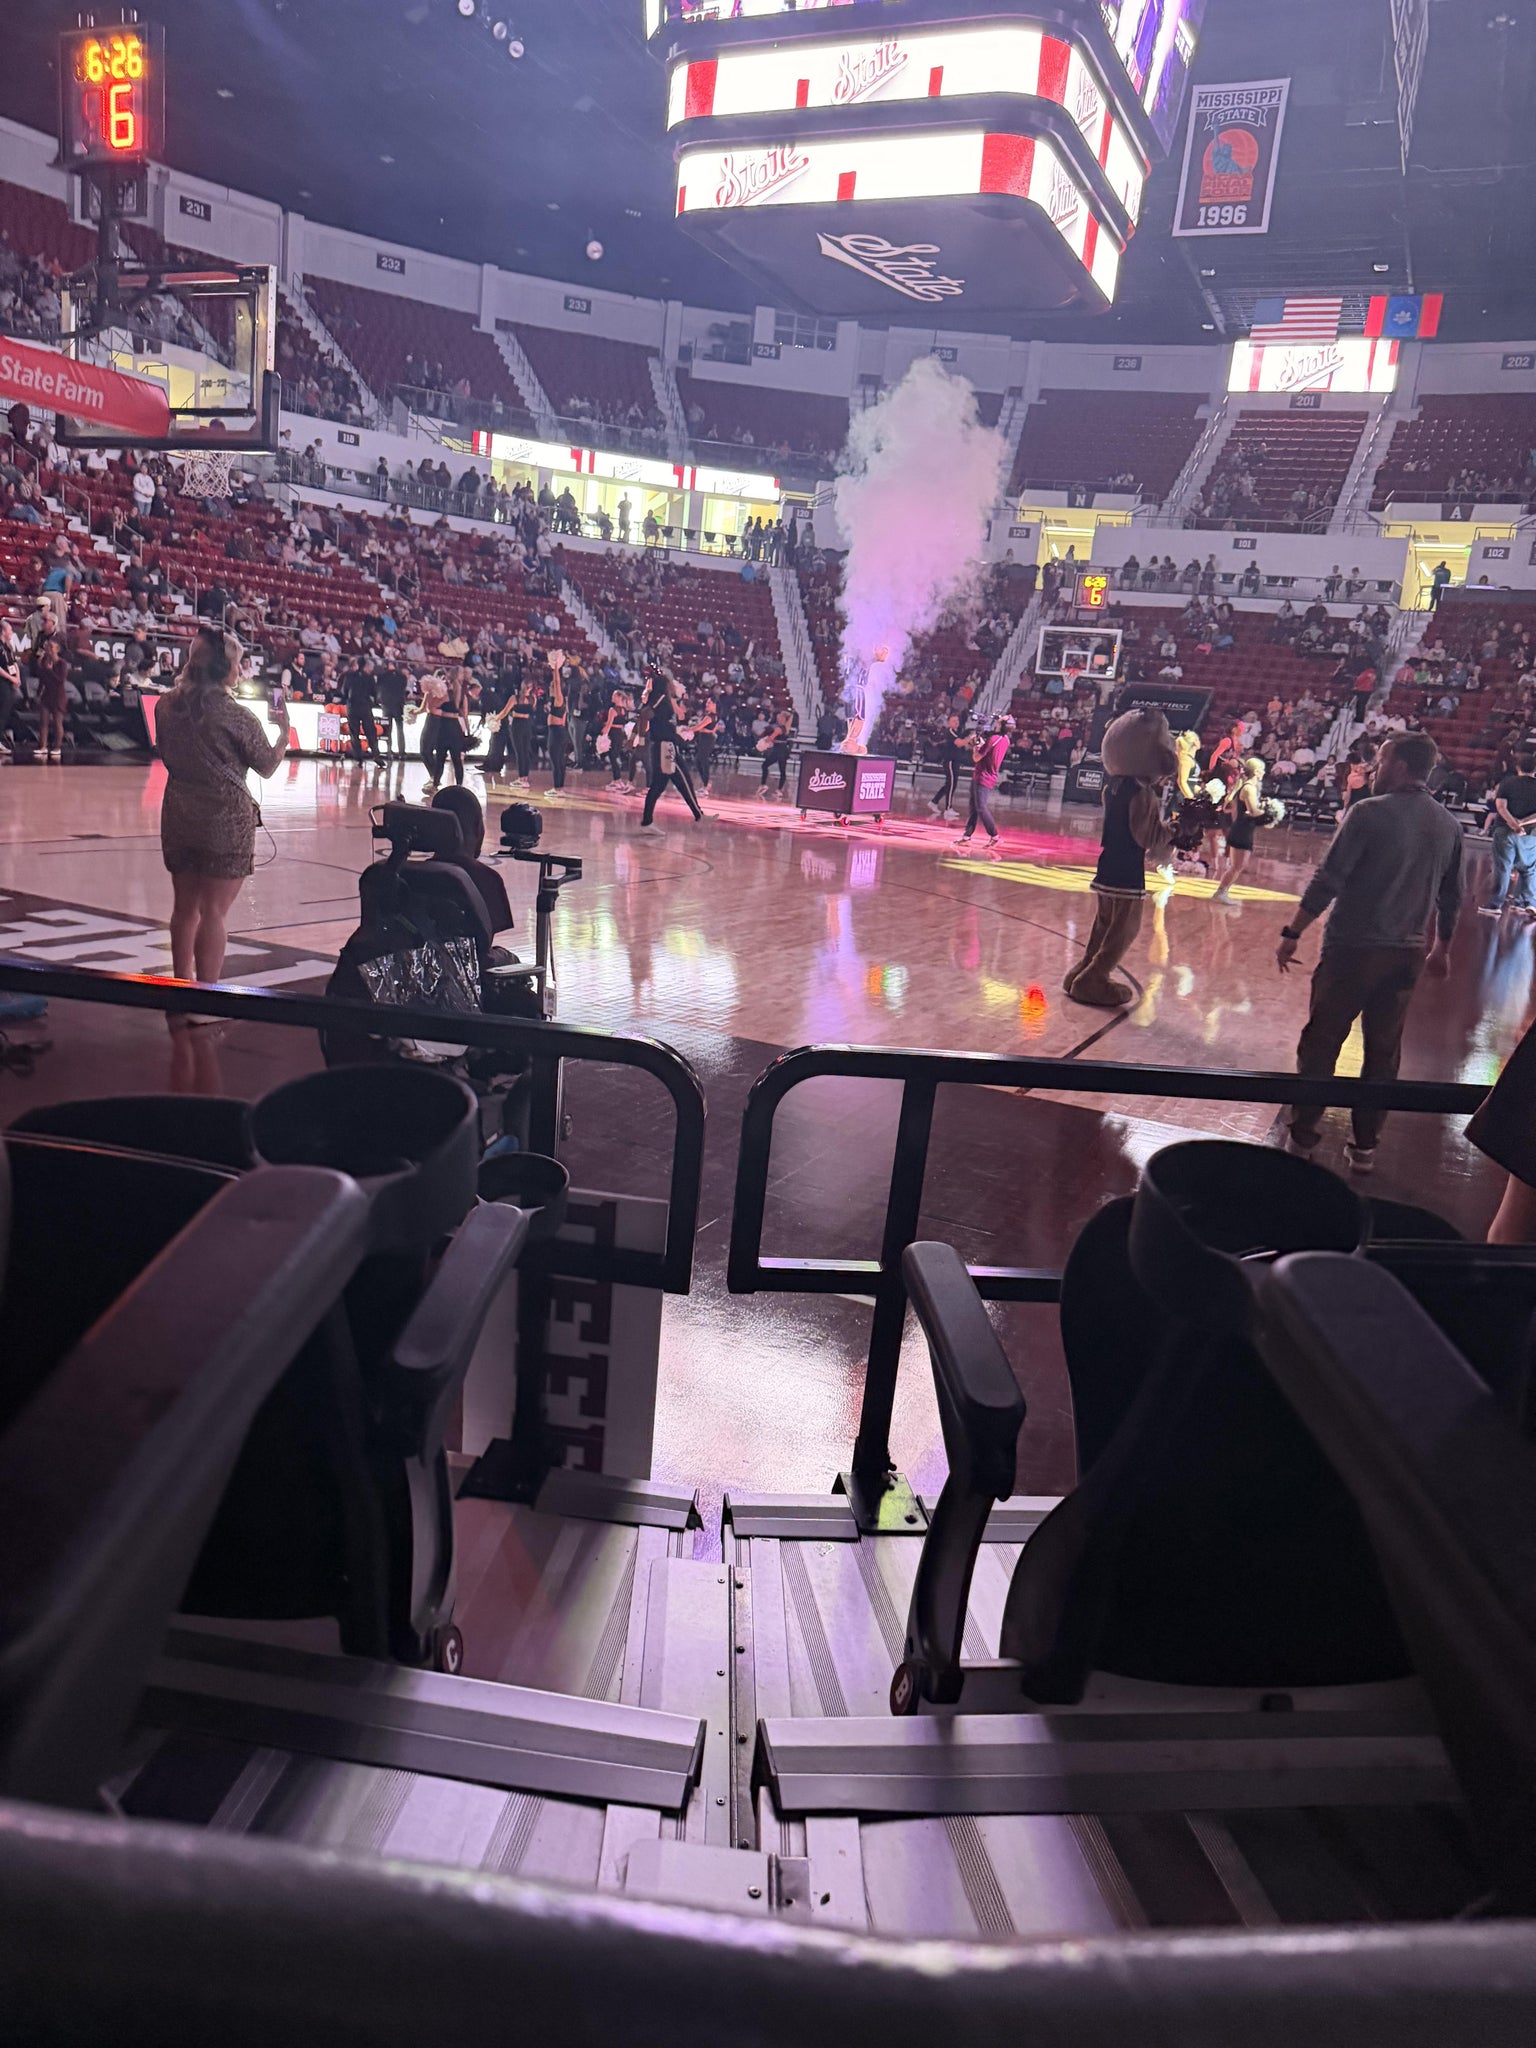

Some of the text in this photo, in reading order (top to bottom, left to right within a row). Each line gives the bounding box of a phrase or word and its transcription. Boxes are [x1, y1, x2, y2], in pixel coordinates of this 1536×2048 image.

[86, 41, 143, 82] 6:26
[1197, 89, 1283, 108] MISSISSIPPI
[110, 84, 135, 148] 6
[1217, 108, 1256, 122] STATE
[186, 200, 205, 217] 231
[1197, 204, 1248, 226] 1996
[381, 256, 401, 271] 232
[816, 231, 966, 302] State
[568, 298, 588, 311] 233
[757, 345, 777, 357] 234
[1506, 356, 1530, 368] 202
[1295, 395, 1316, 407] 201
[1075, 494, 1086, 506] N
[1450, 505, 1463, 519] A
[1239, 539, 1252, 549] 101
[1487, 547, 1505, 558] 102
[1084, 576, 1107, 588] 6:26
[1090, 587, 1102, 605] 6
[808, 767, 847, 793] State
[859, 782, 886, 800] STATE
